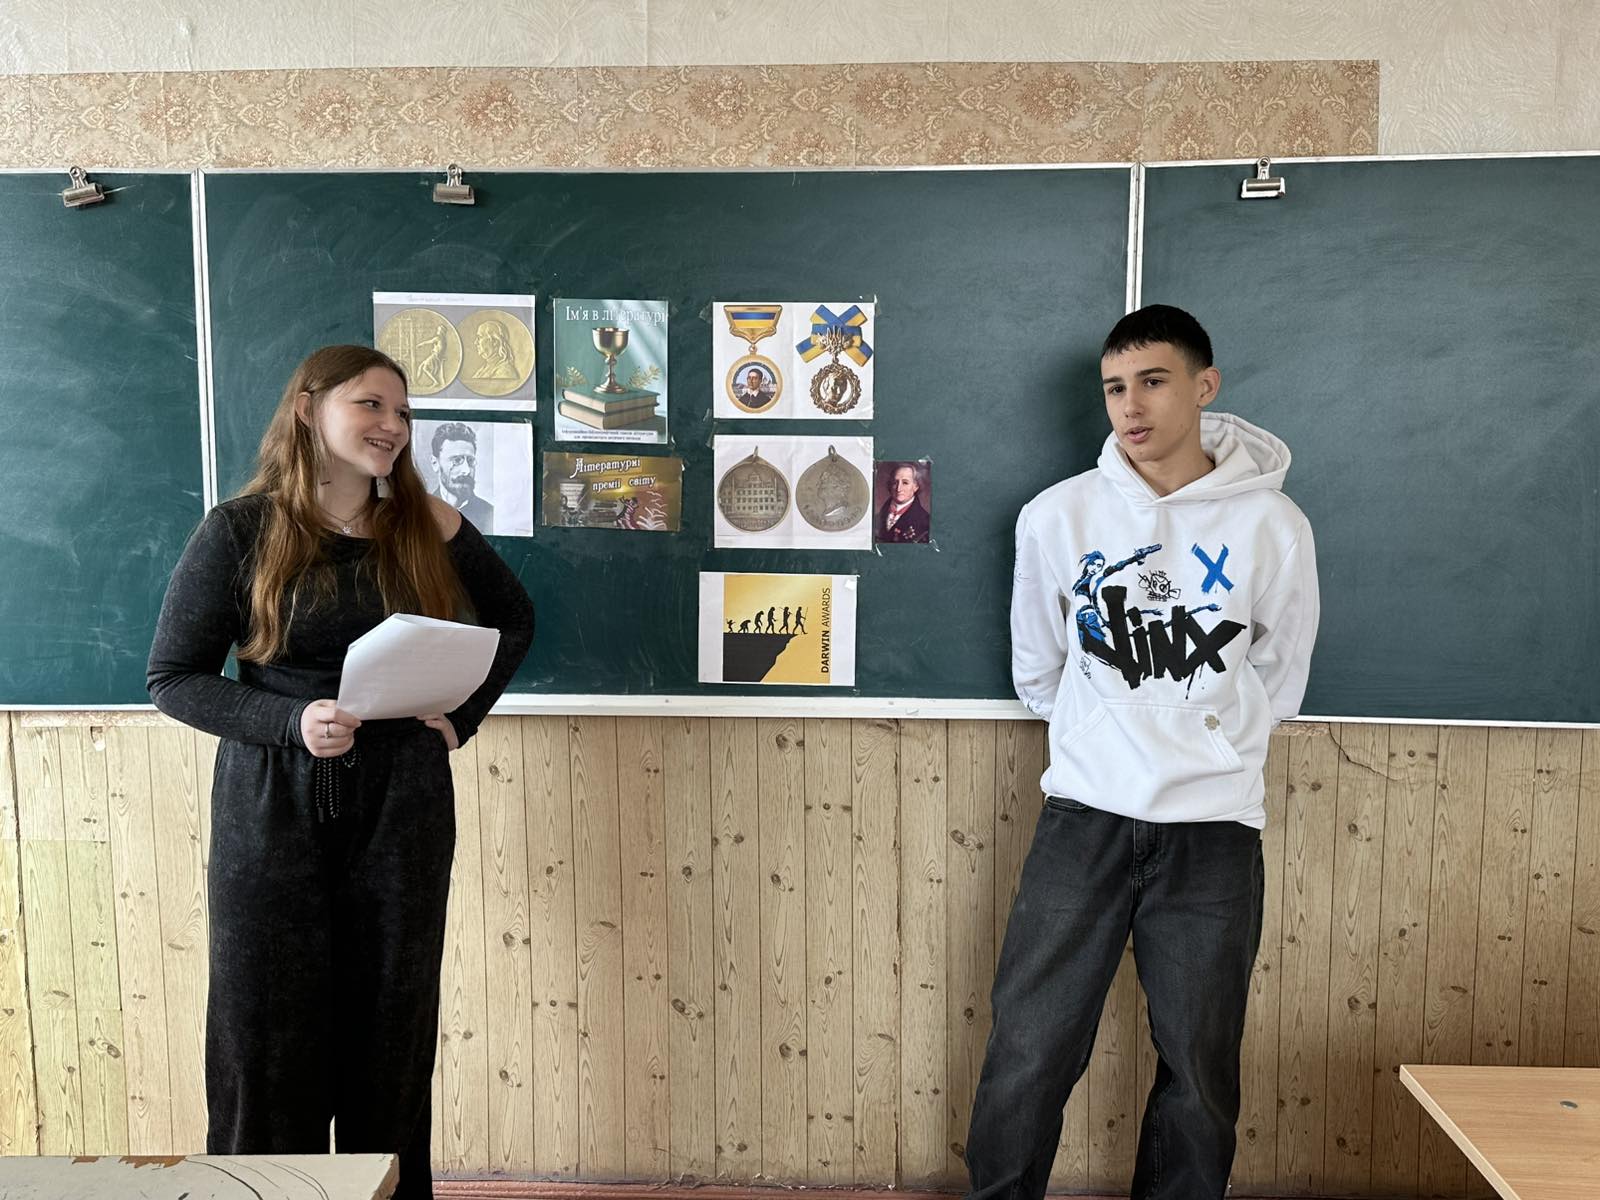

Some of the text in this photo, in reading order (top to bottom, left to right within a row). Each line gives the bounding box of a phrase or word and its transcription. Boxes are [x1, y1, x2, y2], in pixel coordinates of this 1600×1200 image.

[566, 306, 589, 321] Ім'я
[593, 312, 599, 321] в
[569, 457, 641, 479] Літературні
[592, 476, 656, 493] премії світу
[820, 587, 831, 674] DARWIN AWARDS
